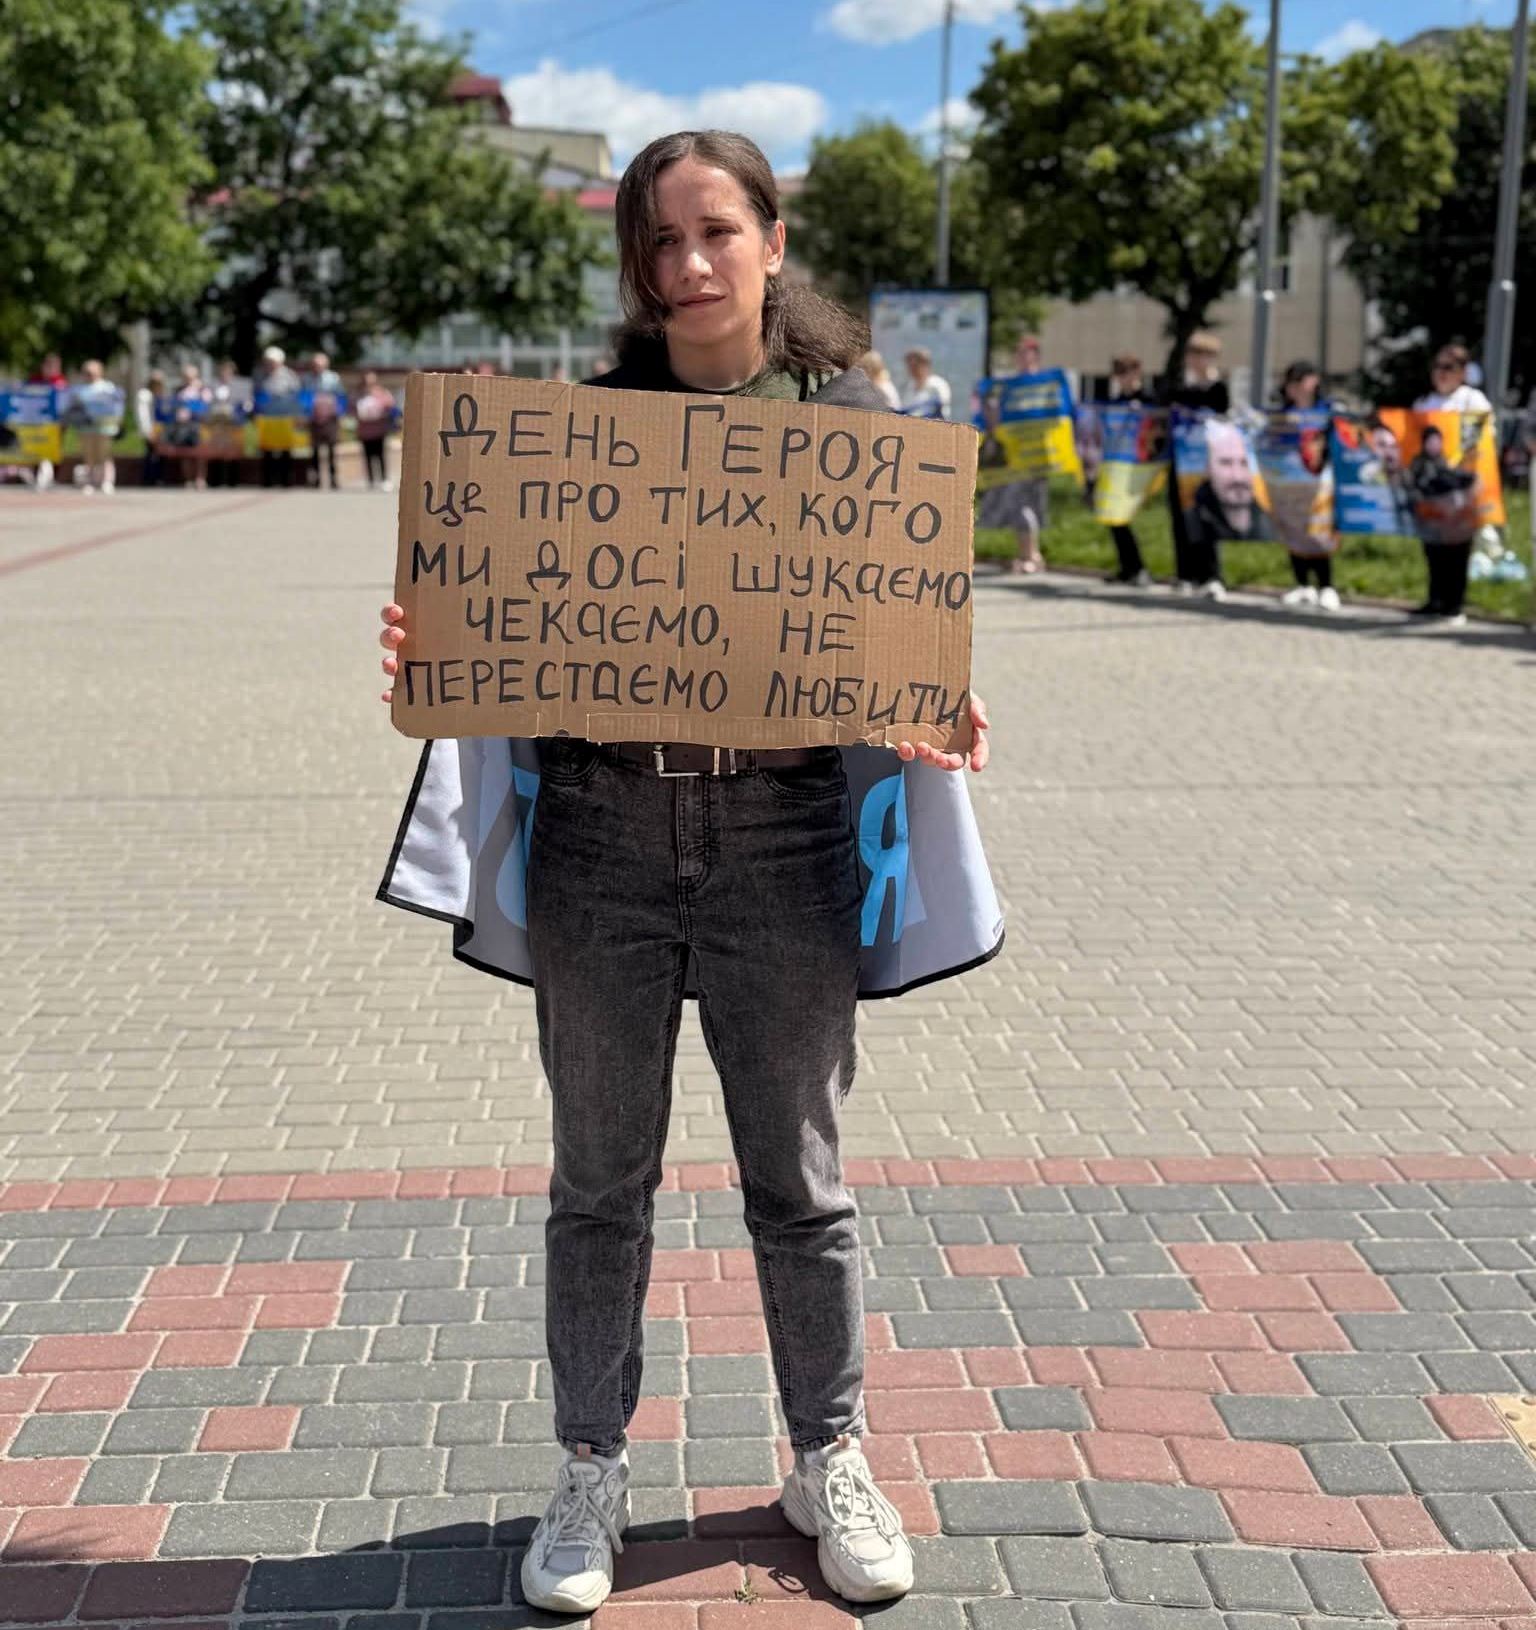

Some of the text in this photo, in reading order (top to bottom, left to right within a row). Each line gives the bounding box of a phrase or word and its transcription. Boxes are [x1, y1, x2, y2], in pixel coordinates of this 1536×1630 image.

[439, 393, 639, 469] ДЕНЬ
[519, 480, 621, 523] ПРО
[799, 492, 942, 544] КОГО
[411, 539, 491, 588] МИ
[779, 608, 857, 656] НЕ
[763, 669, 967, 730] ЛЮБИТИ
